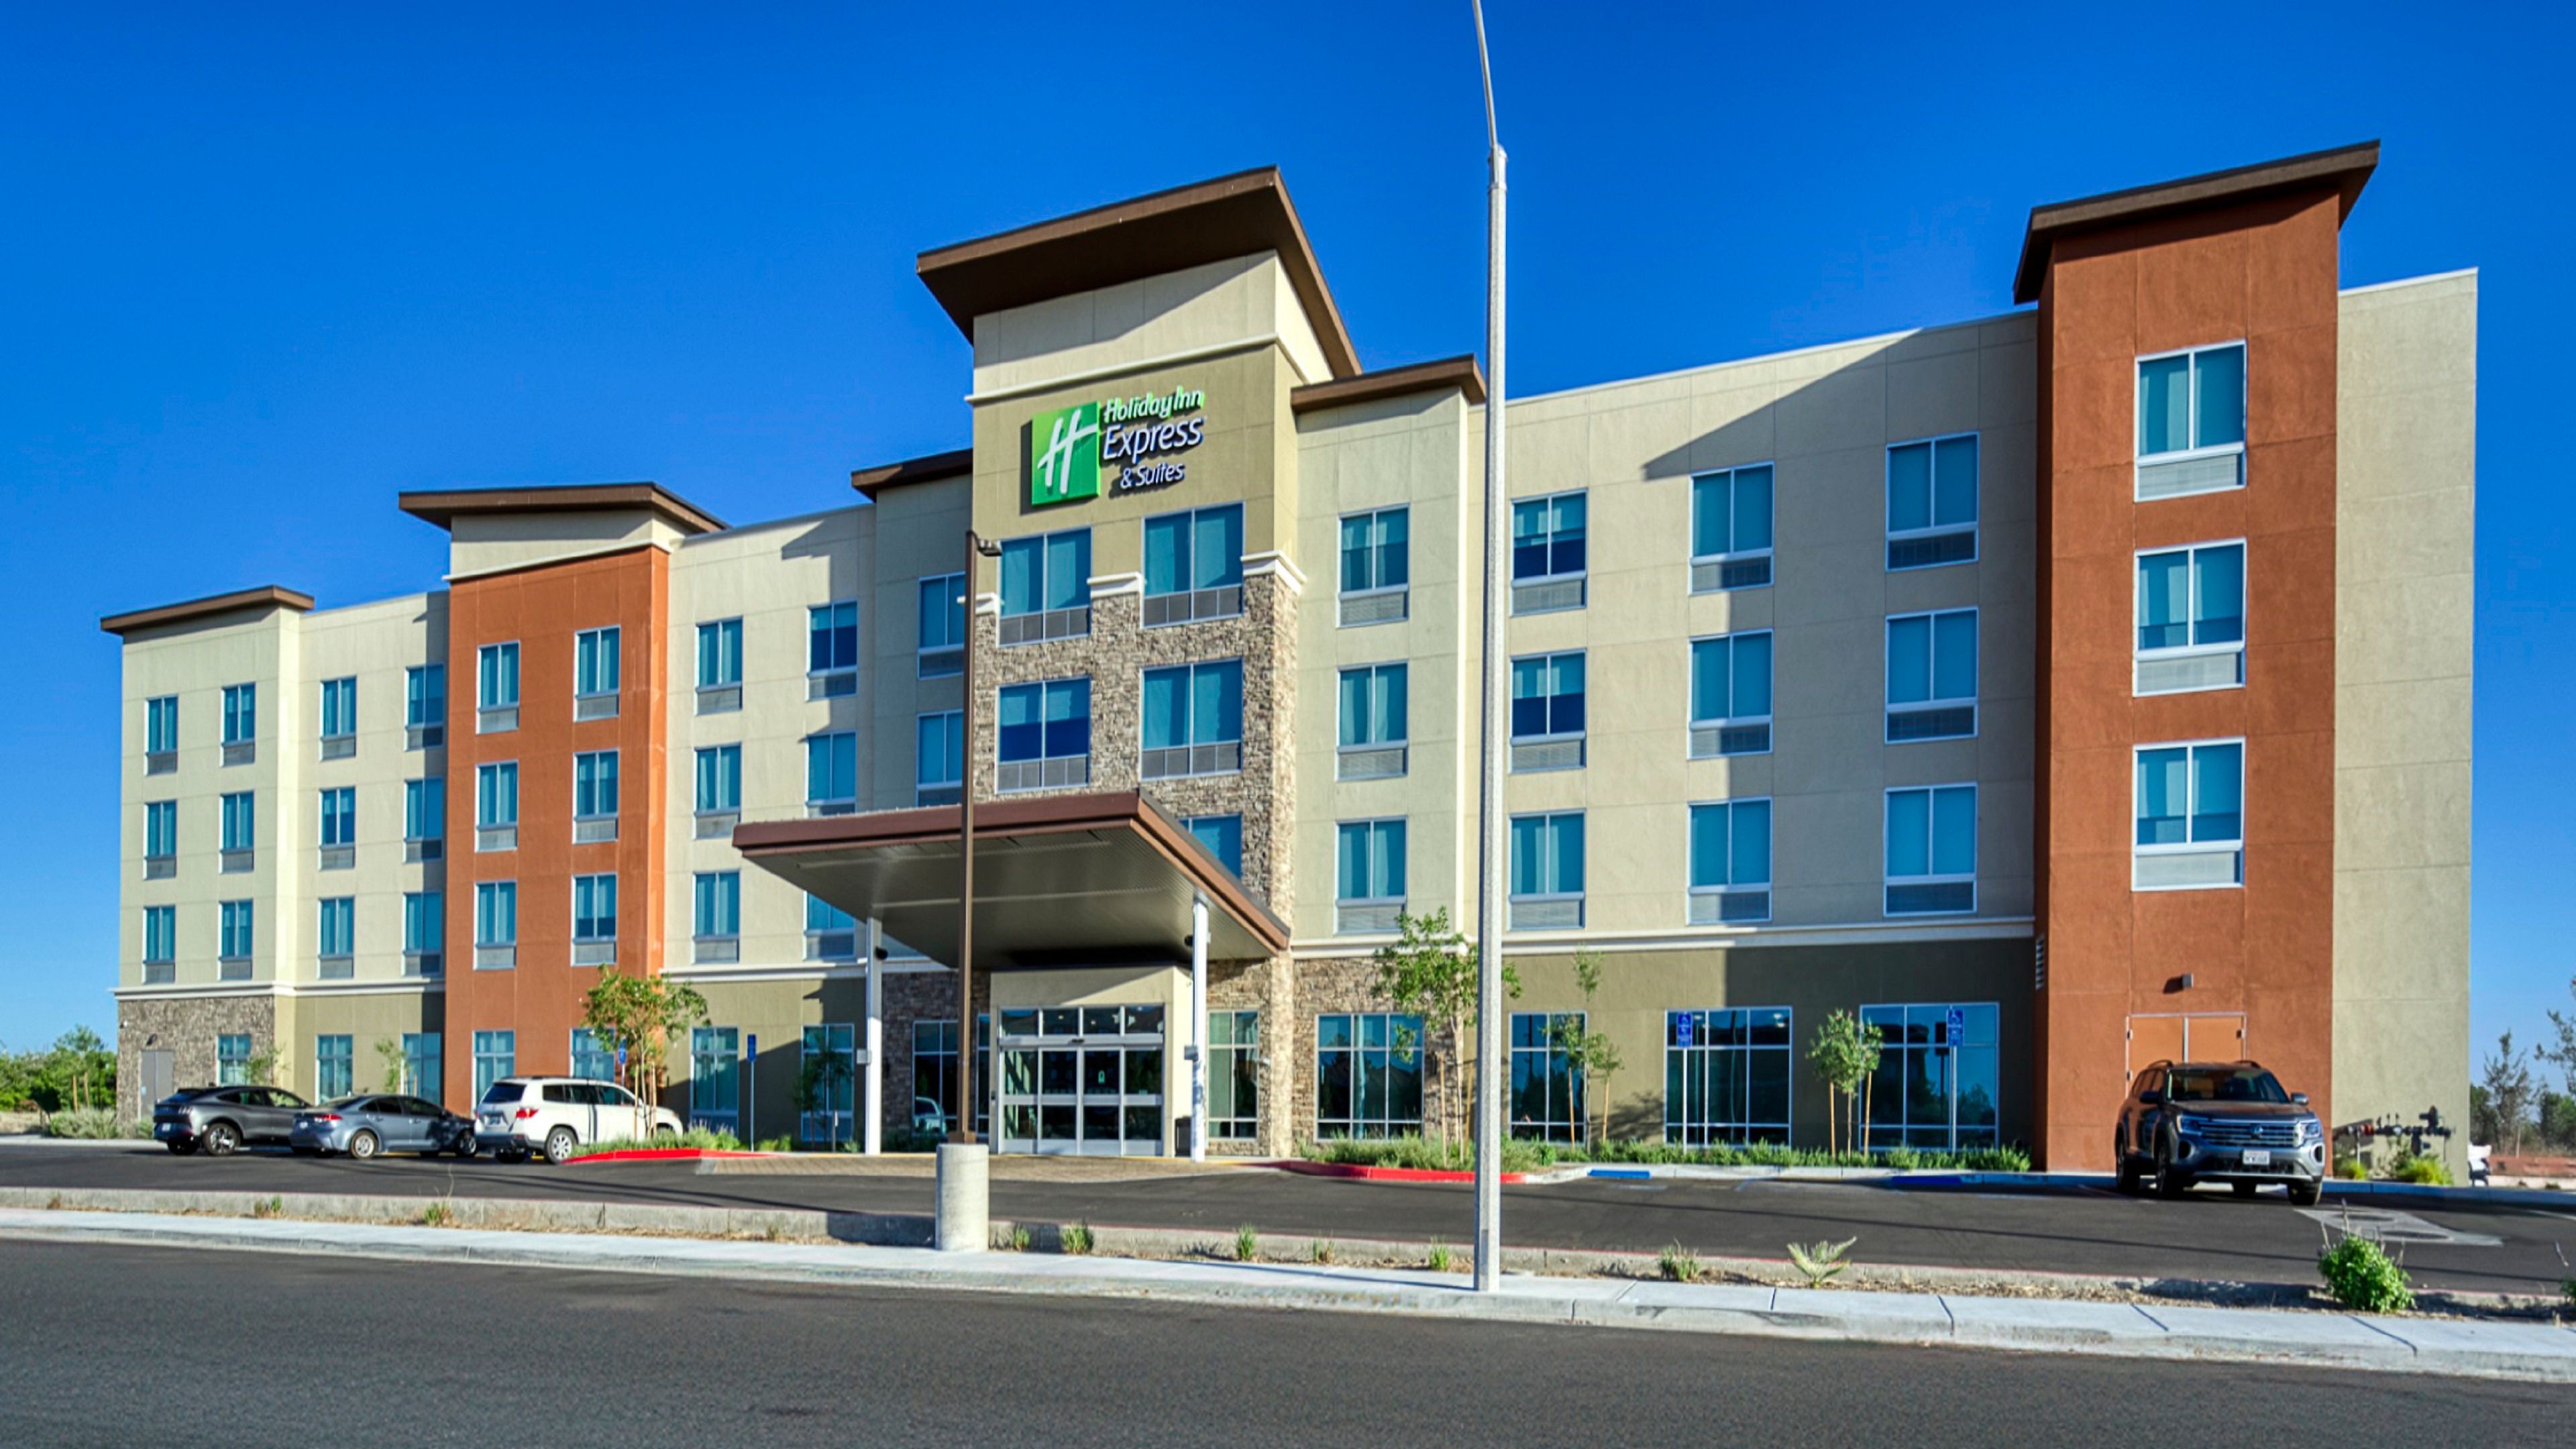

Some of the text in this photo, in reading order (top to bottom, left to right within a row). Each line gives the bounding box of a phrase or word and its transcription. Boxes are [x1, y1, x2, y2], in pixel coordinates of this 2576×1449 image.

[1104, 385, 1205, 423] Holiday Inn
[1037, 407, 1098, 495] H
[1103, 417, 1204, 465] Express
[1120, 462, 1185, 490] & Suites
